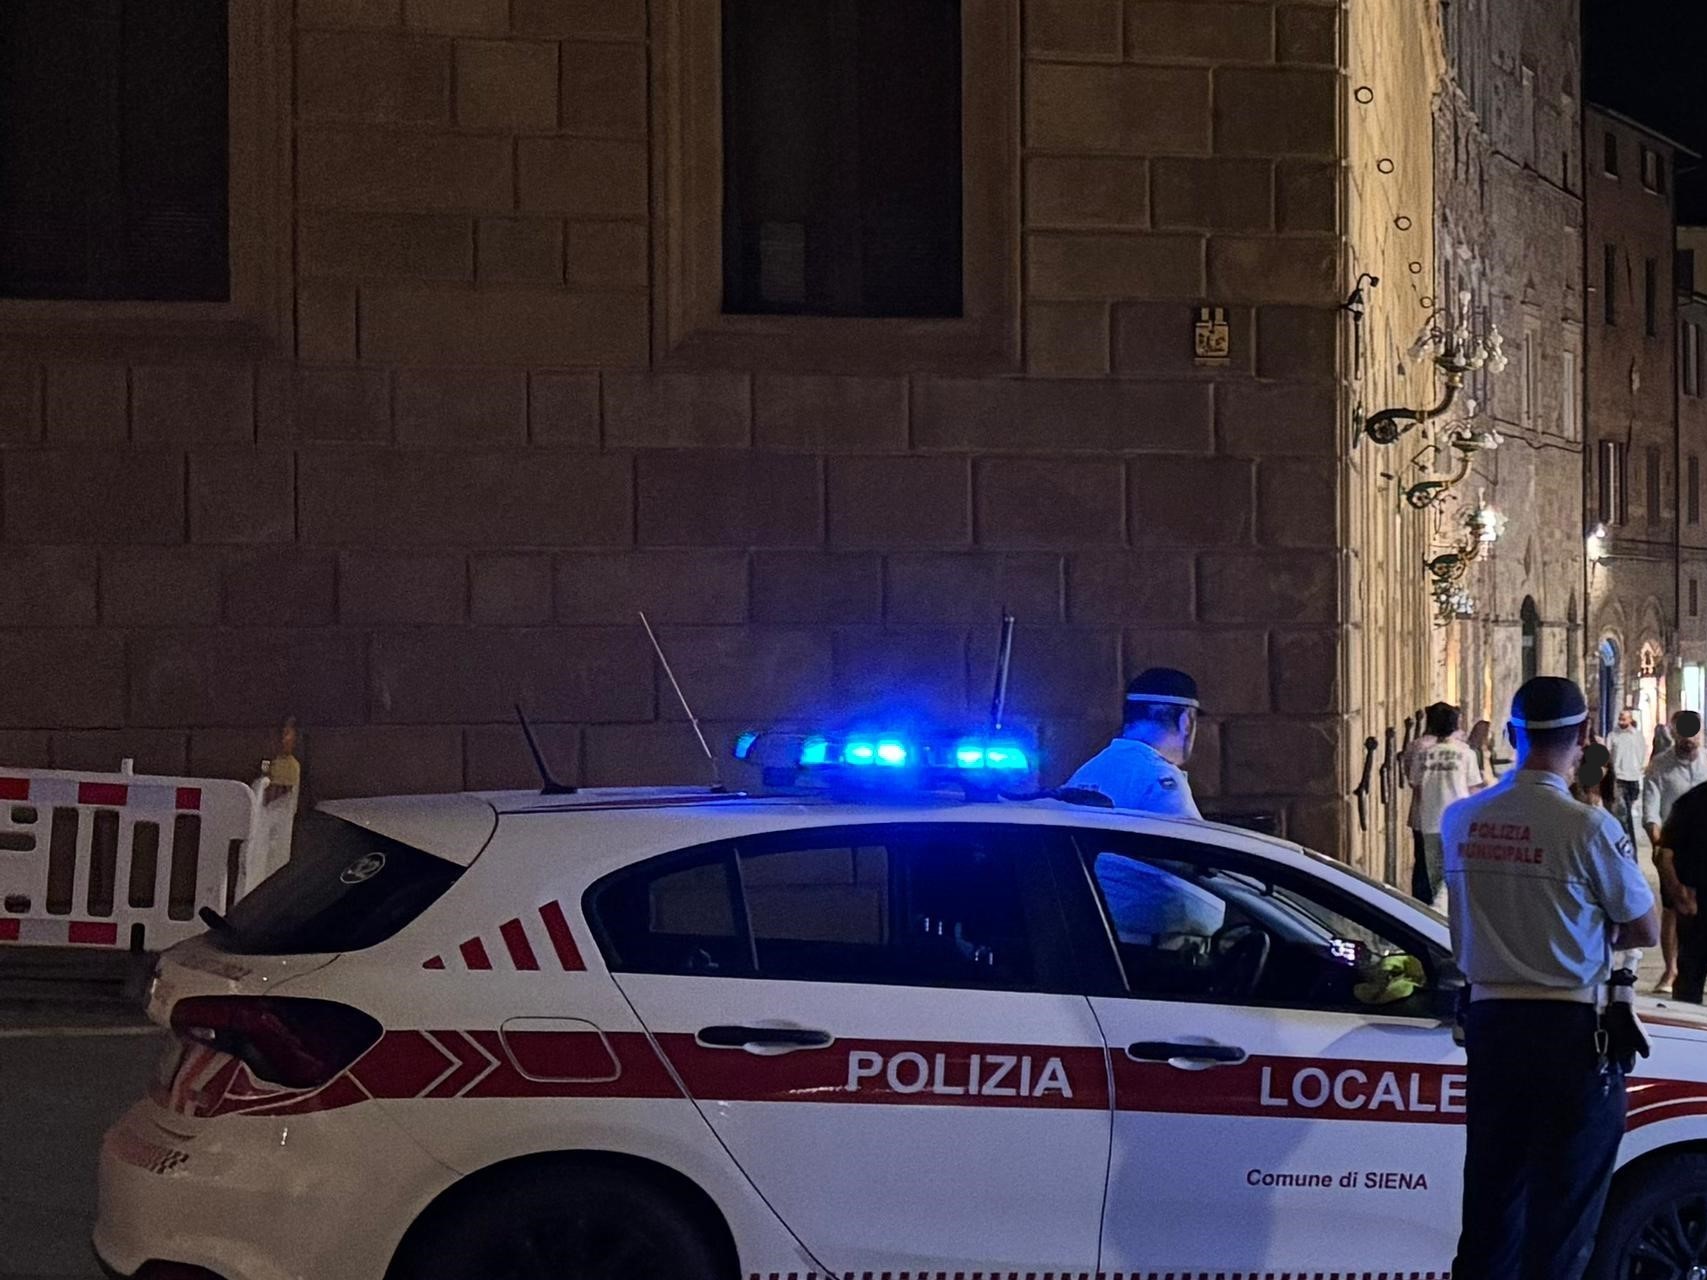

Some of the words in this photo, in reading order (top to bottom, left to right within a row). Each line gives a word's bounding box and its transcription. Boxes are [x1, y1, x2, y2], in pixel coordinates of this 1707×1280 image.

[1468, 822, 1531, 841] POLIZIA
[1457, 842, 1544, 864] MUNICIPALE
[848, 1050, 1073, 1098] POLIZIA
[1260, 1066, 1467, 1113] LOCALE
[1246, 1168, 1333, 1188] Comune
[1339, 1171, 1358, 1188] di
[1364, 1171, 1428, 1190] SIENA
